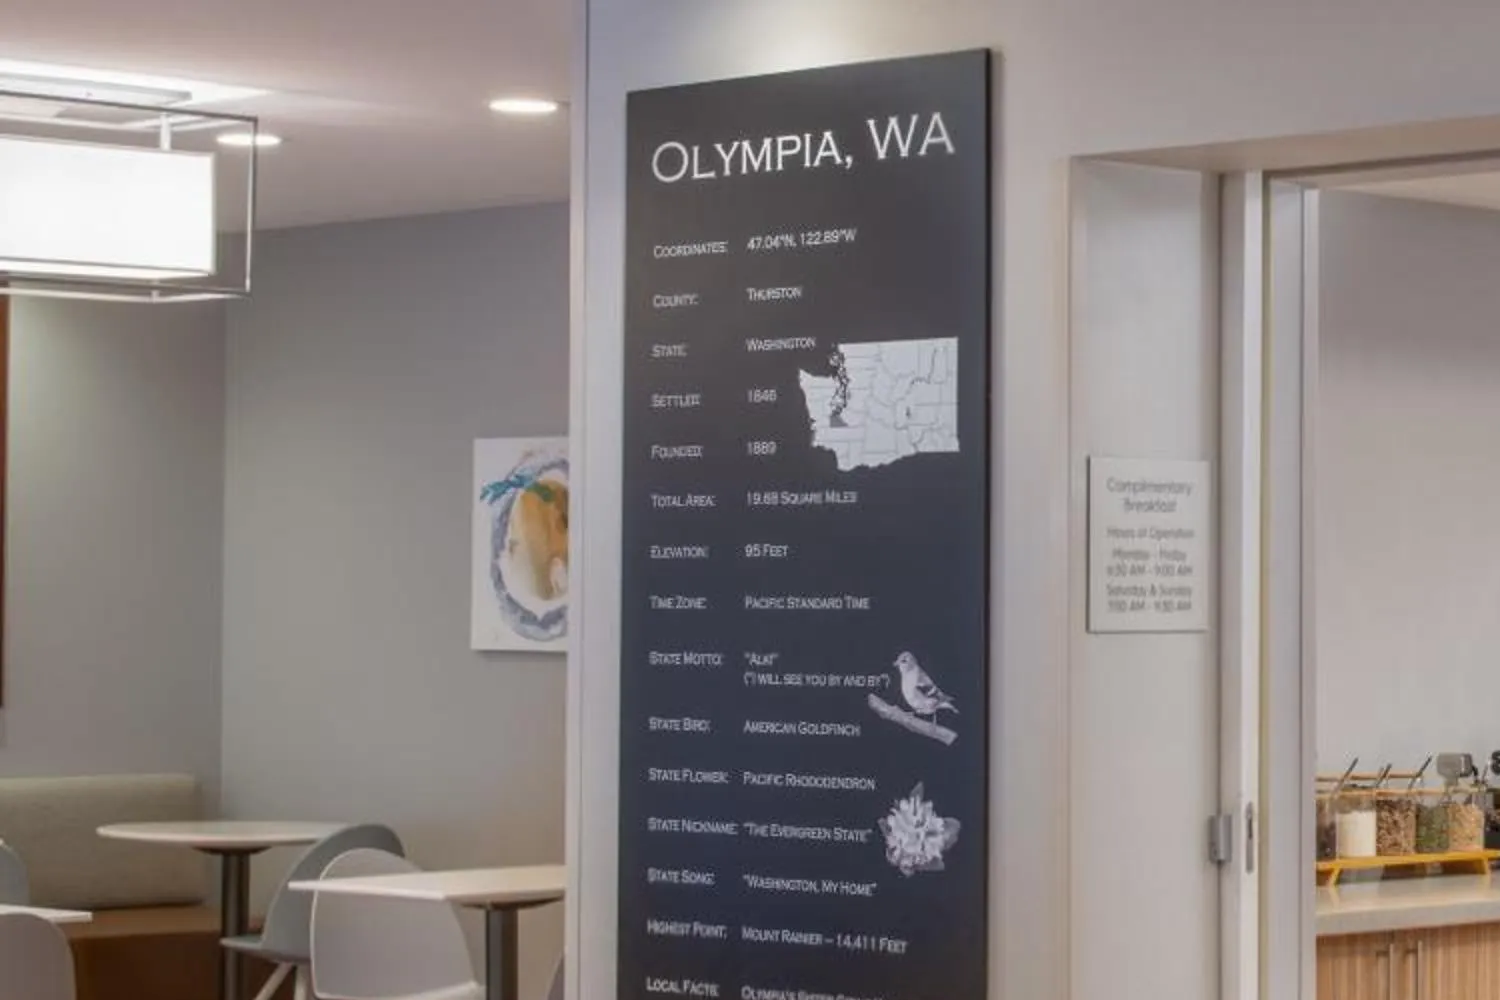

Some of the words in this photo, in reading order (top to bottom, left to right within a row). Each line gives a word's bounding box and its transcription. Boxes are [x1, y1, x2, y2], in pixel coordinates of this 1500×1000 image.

[652, 130, 853, 182] OLYMPIA,
[867, 111, 956, 160] WA
[747, 286, 801, 302] THURSTON
[746, 337, 816, 351] WASHINGTON
[1106, 476, 1193, 496] Complimentary
[651, 494, 683, 507] TOTAL
[781, 491, 822, 505] SQUARE
[826, 491, 857, 504] MILES
[1123, 498, 1177, 513] Breakfast
[650, 545, 709, 559] ELEVATION:
[745, 544, 760, 557] 95
[763, 544, 789, 557] FEET
[650, 596, 674, 609] TIME
[745, 596, 785, 610] PACIFIC
[787, 596, 843, 610] STANDARD
[846, 596, 870, 610] TIME
[650, 652, 682, 666] STATE
[757, 674, 782, 687] WILL
[783, 674, 802, 688] SEE
[805, 675, 827, 688] YOU
[828, 675, 843, 688] BY
[844, 676, 866, 688] AND
[649, 717, 680, 731] STATE
[744, 721, 796, 735] AMERICAN
[798, 721, 861, 737] GOLDFINCH
[649, 768, 681, 781] STATE
[743, 771, 783, 787] PACIFIC
[785, 773, 875, 791] RHODODENDRON
[648, 818, 680, 833] STATE
[770, 824, 832, 840] EVERGREEN
[648, 868, 680, 883] STATE
[822, 880, 839, 894] MY
[647, 920, 691, 937] HIGHEST
[742, 926, 780, 942] MOUNT
[781, 929, 823, 946] RAINIER
[836, 933, 875, 950] 14,411
[879, 937, 908, 954] FEET
[646, 977, 682, 994] LOCAL
